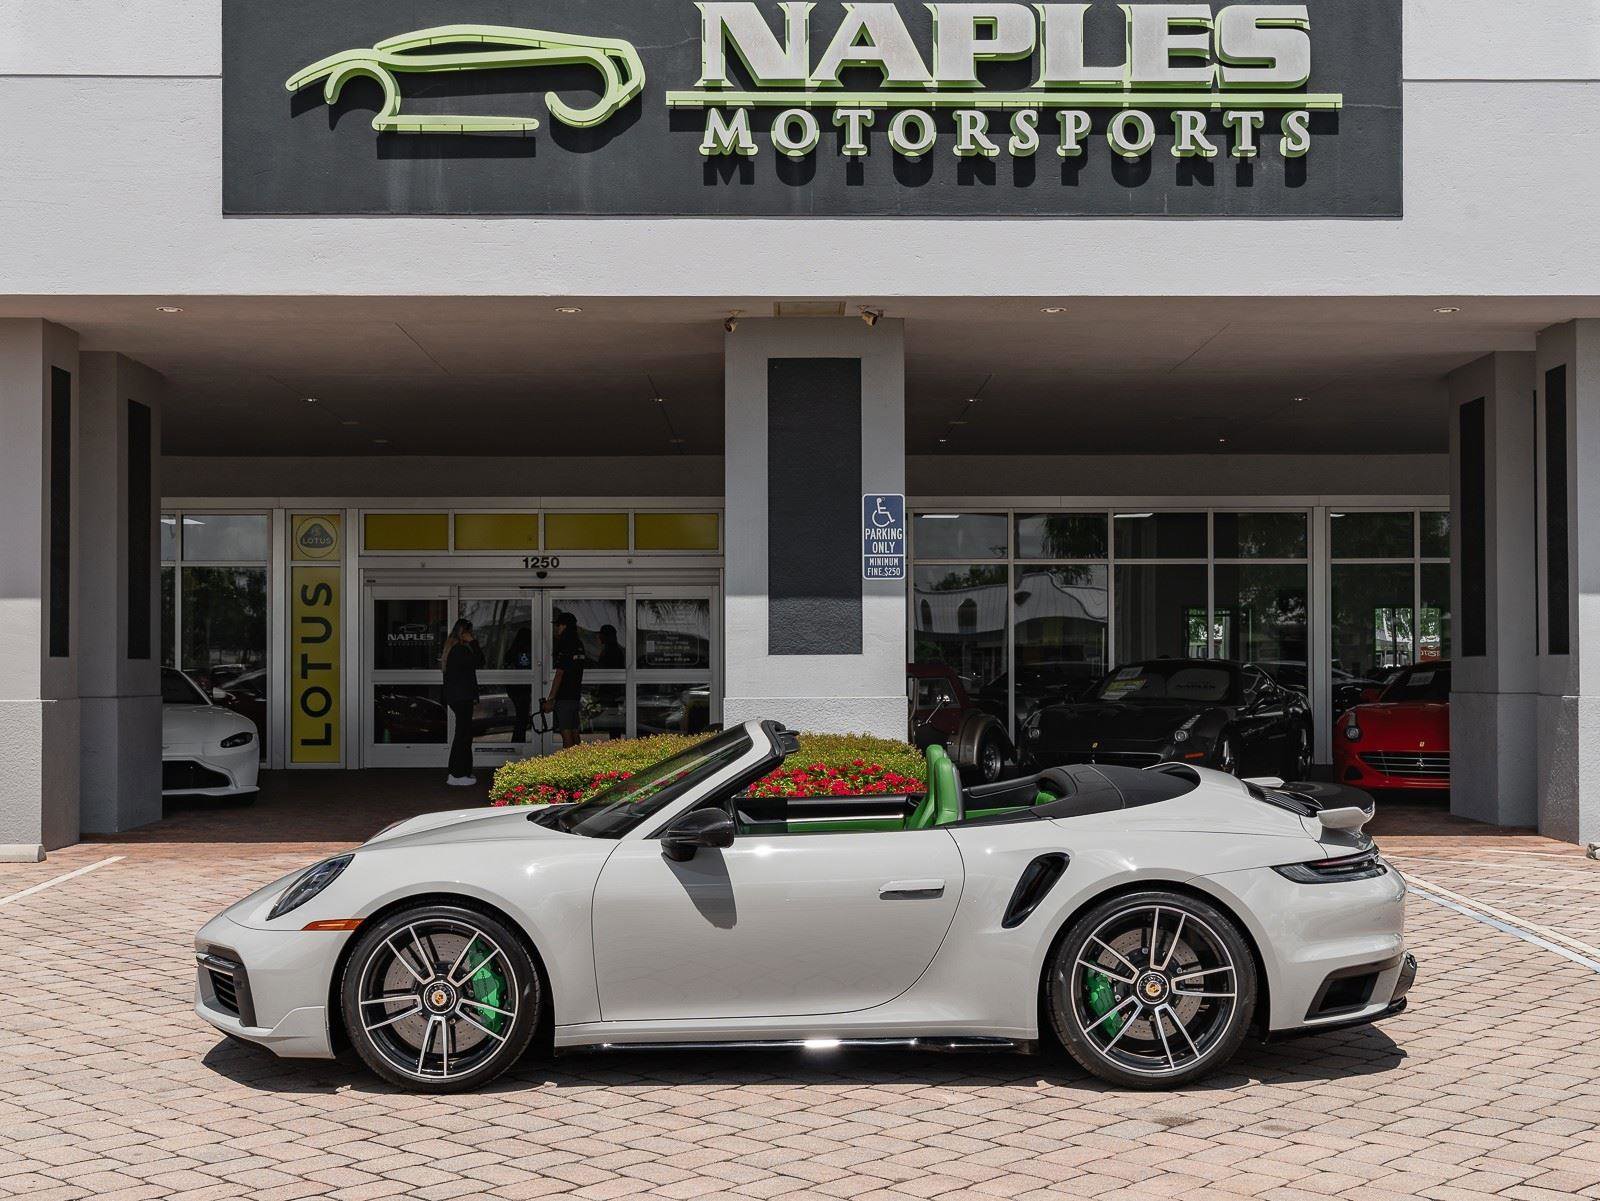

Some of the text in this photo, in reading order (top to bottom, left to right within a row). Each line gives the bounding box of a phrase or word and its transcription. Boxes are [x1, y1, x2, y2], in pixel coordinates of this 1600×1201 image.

[694, 2, 1312, 88] NAPLES
[699, 108, 1311, 156] MOTORSPORTS
[865, 528, 903, 539] PARKING
[303, 537, 331, 545] LOTUS
[872, 541, 895, 553] ONLY
[522, 556, 560, 569] 1250
[869, 557, 899, 566] MINIMUM
[867, 567, 901, 577] FINE $250
[387, 633, 435, 641] NAPLES
[301, 582, 333, 746] LOTUS
